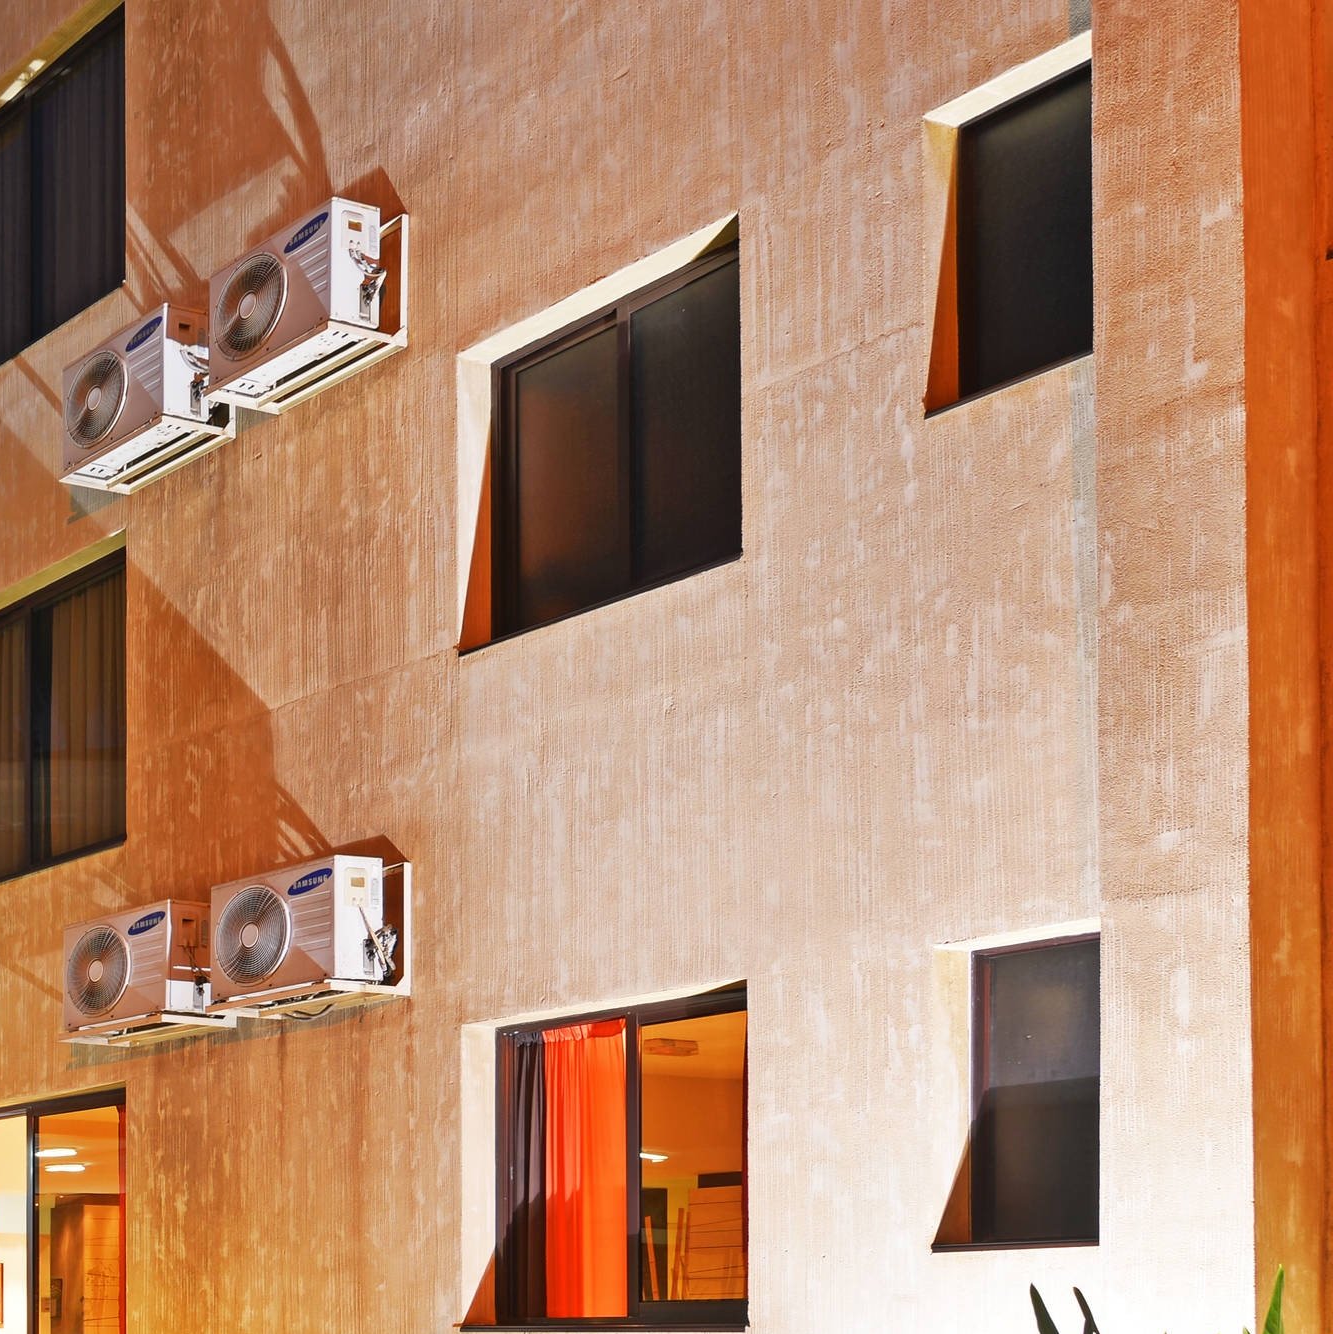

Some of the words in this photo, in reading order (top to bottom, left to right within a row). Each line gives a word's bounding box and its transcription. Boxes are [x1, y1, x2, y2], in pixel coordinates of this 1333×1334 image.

[288, 219, 325, 247] SAMSUNG
[293, 874, 328, 890] SAMSUNG
[132, 916, 161, 929] SAMSUNG
